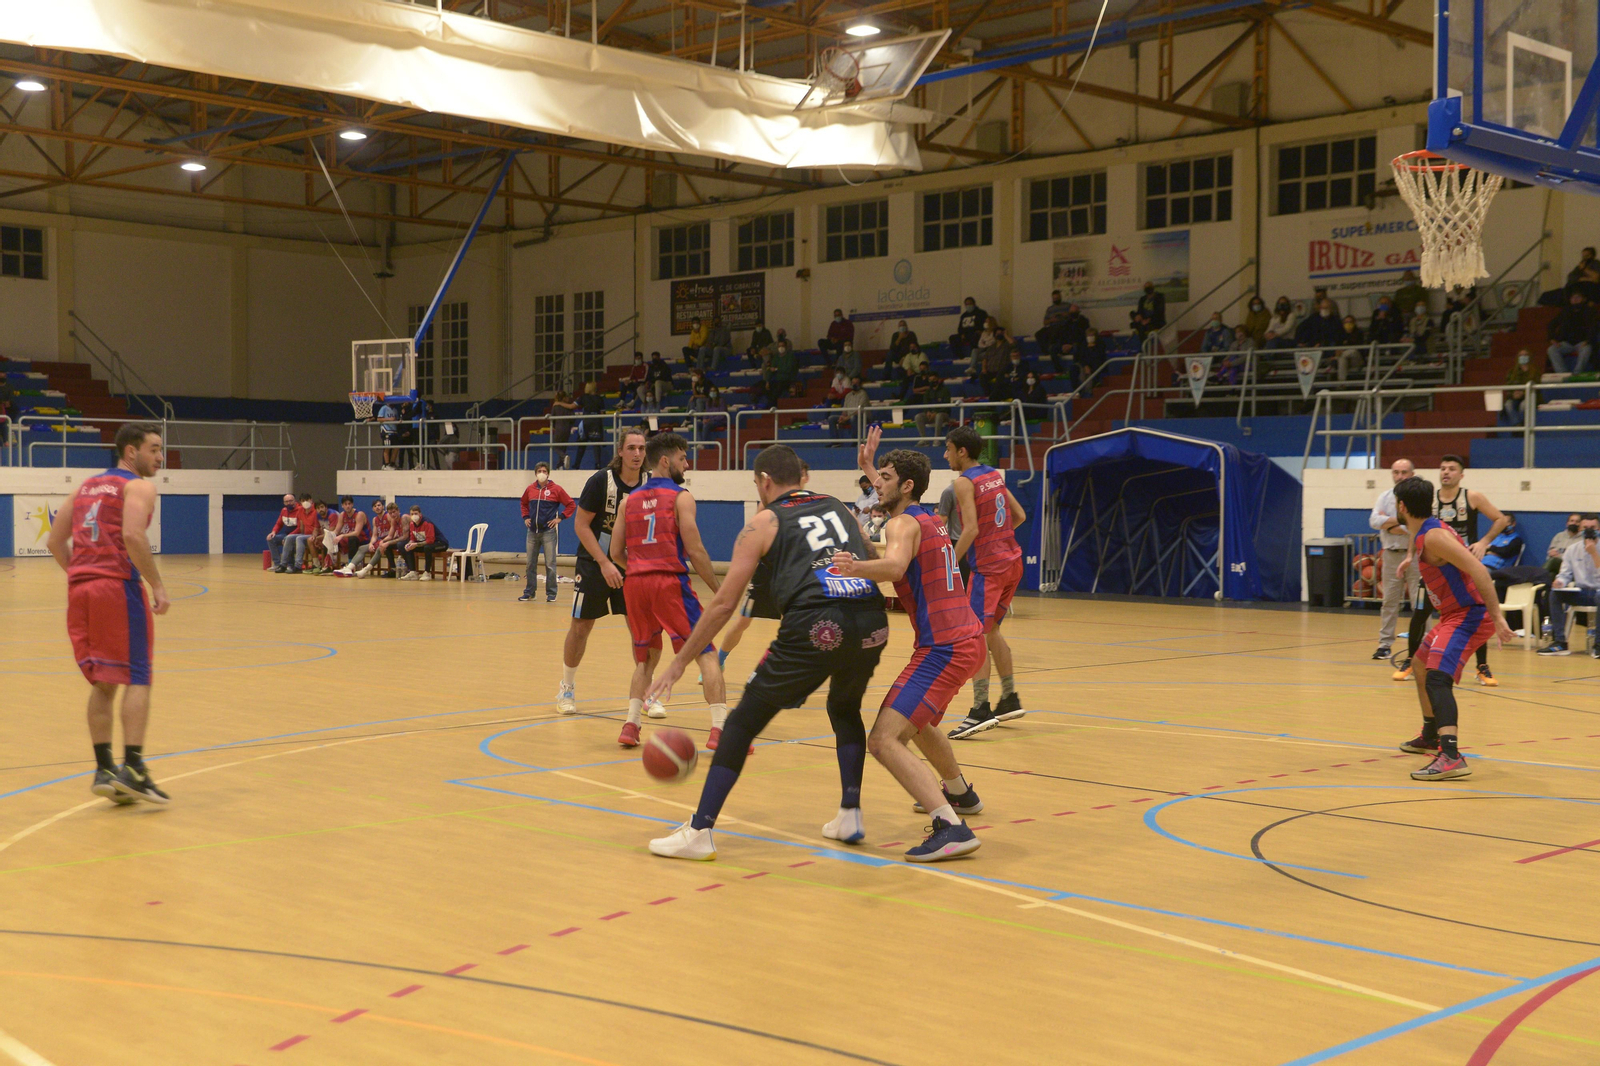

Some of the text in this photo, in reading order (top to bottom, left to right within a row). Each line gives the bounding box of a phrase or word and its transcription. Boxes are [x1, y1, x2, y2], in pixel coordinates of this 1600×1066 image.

[877, 286, 930, 303] laColada
[676, 309, 714, 319] RESTAURANTE
[82, 498, 102, 542] 4
[994, 492, 1007, 528] 8
[641, 512, 658, 545] 1
[797, 510, 849, 551] 21
[27, 548, 46, 556] Moreno
[1026, 555, 1037, 565] M
